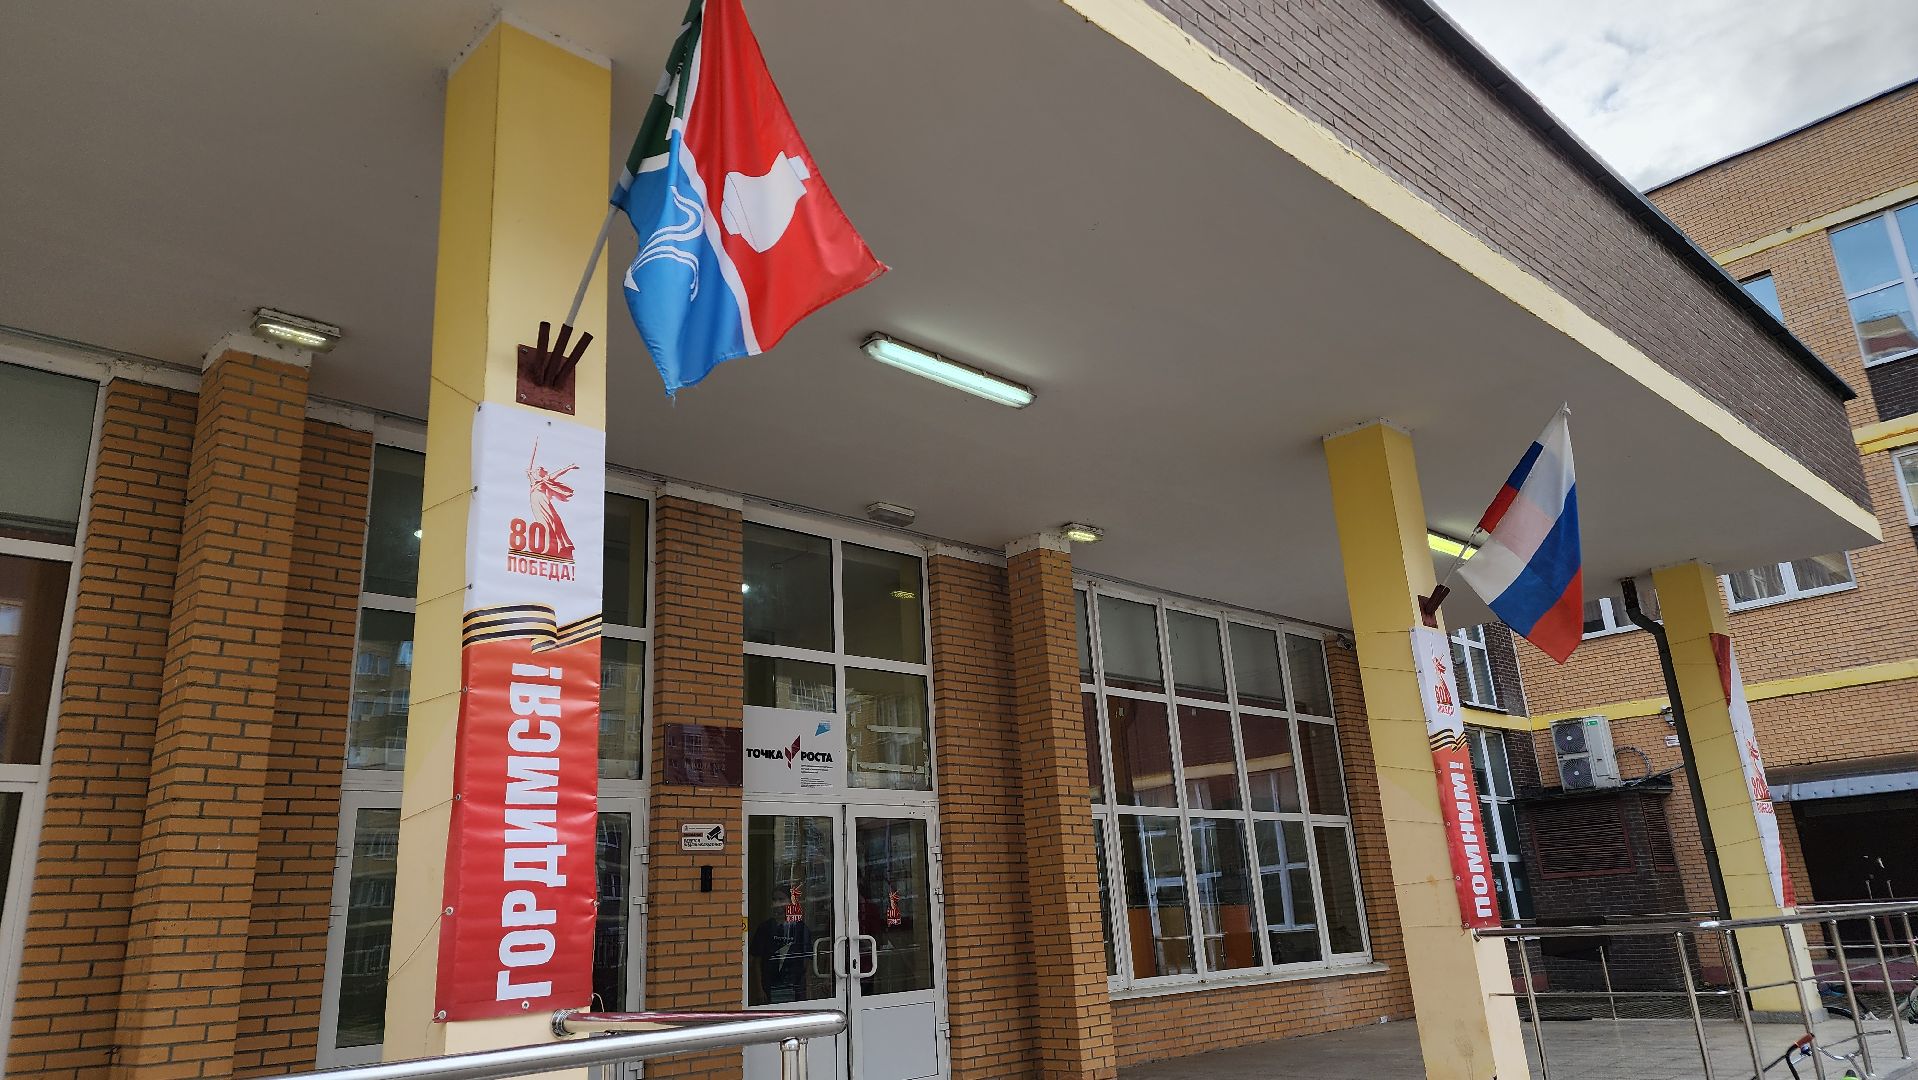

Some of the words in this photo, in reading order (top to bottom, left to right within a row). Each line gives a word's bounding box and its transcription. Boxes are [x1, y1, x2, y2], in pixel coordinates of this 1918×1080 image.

[509, 518, 546, 553] 80
[507, 556, 575, 582] ПОБЕДА!
[746, 748, 783, 760] ТОЧКА
[801, 751, 833, 762] РОСТА
[496, 662, 567, 1002] ГОРДИМСЯ!
[1449, 761, 1493, 918] ПОМНИМ!
